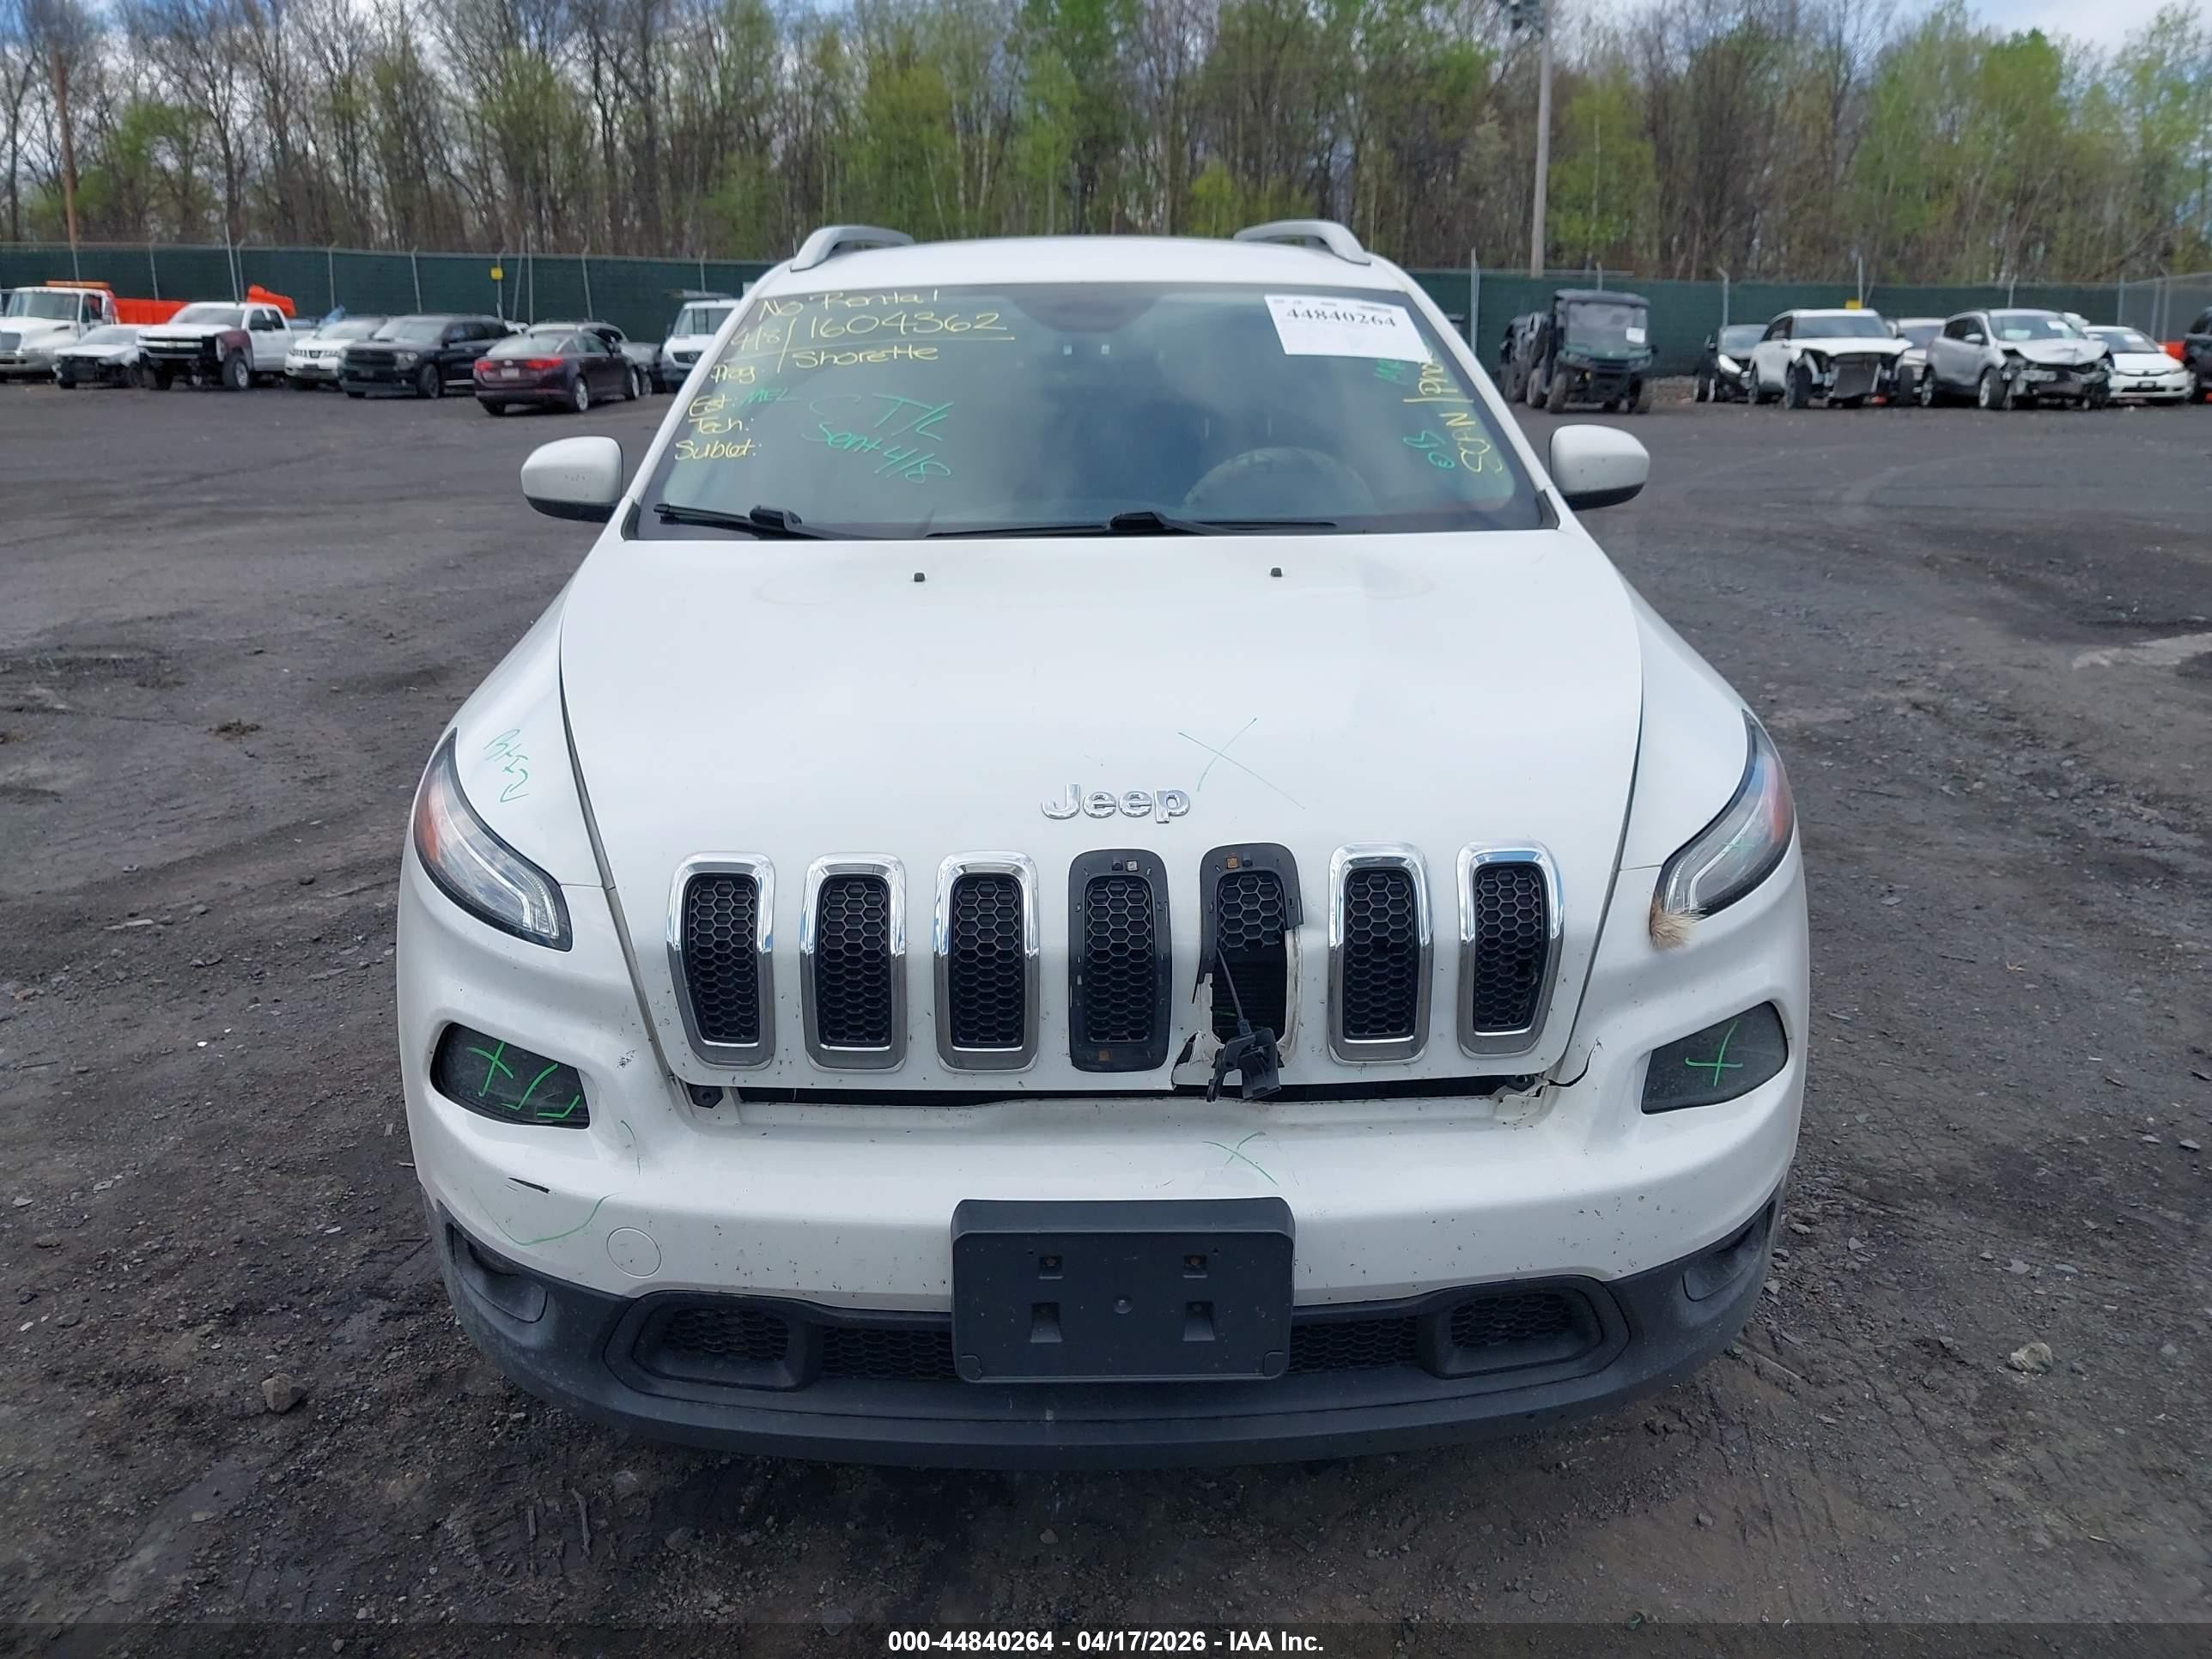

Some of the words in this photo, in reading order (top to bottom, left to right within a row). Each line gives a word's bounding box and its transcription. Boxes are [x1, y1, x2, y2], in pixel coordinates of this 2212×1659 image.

[758, 299, 804, 322] No
[1286, 308, 1397, 327] 44840264
[811, 311, 1007, 339] 1604362
[1042, 782, 1191, 824] Jeep
